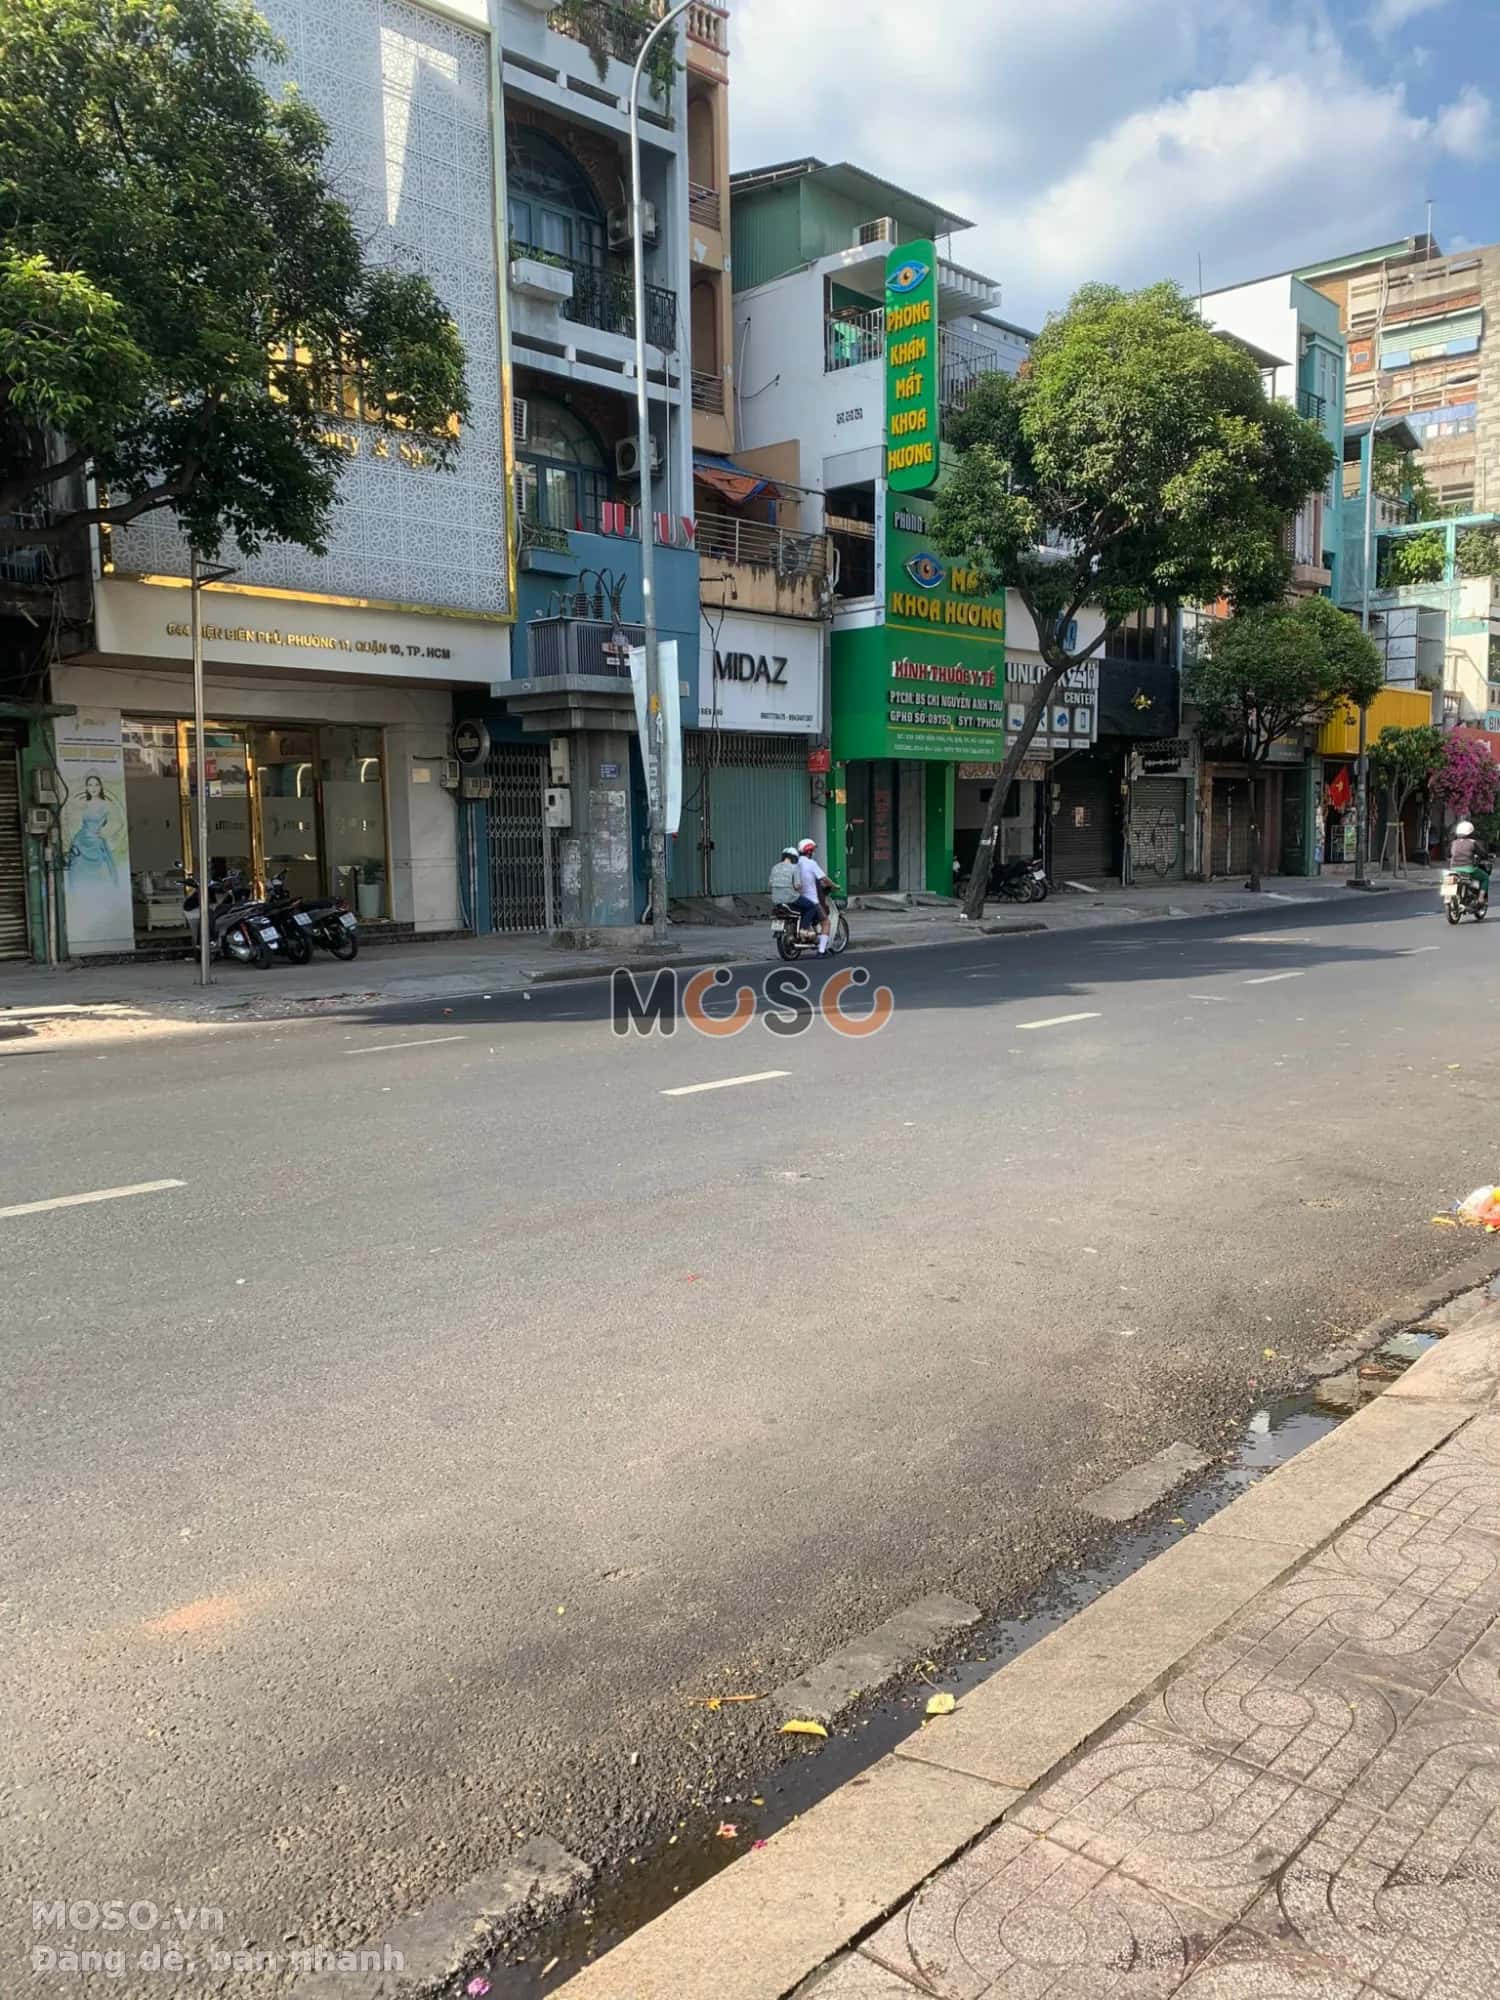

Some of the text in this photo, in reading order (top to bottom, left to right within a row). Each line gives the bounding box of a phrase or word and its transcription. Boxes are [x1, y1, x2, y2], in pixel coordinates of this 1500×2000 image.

[890, 408, 928, 436] KHOA
[891, 591, 941, 622] KHOA
[713, 650, 788, 686] MIDAZ
[1063, 692, 1096, 705] CENTER
